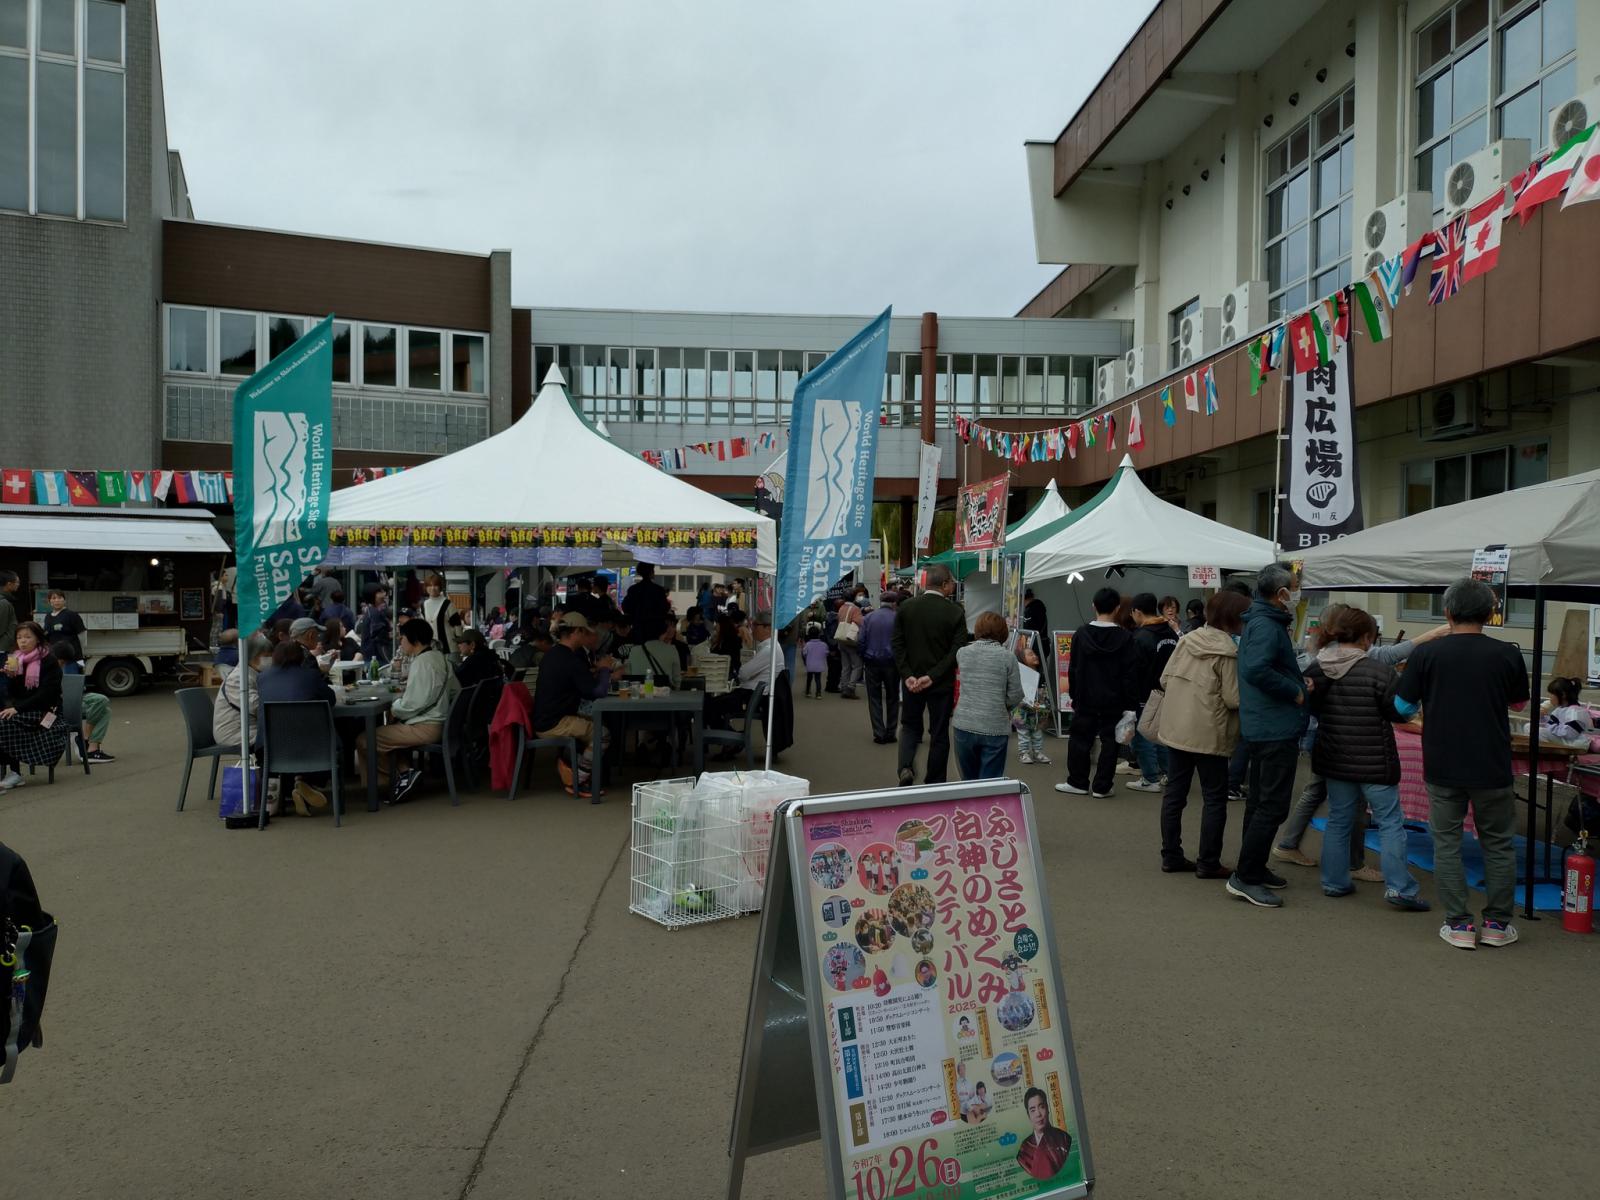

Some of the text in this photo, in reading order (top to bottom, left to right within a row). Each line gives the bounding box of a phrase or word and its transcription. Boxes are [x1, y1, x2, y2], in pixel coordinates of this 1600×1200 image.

[860, 410, 874, 447] World
[1305, 358, 1343, 478] 肉広場
[307, 423, 324, 529] World Heritage Site
[855, 451, 869, 500] Heritage
[854, 504, 866, 528] Site
[253, 554, 270, 616] Fujisato,
[270, 550, 295, 610] San
[797, 546, 813, 601] Fujisato,
[986, 806, 1027, 934] ふじさと
[924, 815, 972, 1000] フェスティバル
[953, 808, 1009, 1005] 白神のめぐみ
[948, 1001, 978, 1015] 2025
[851, 1152, 882, 1170] 令和7年
